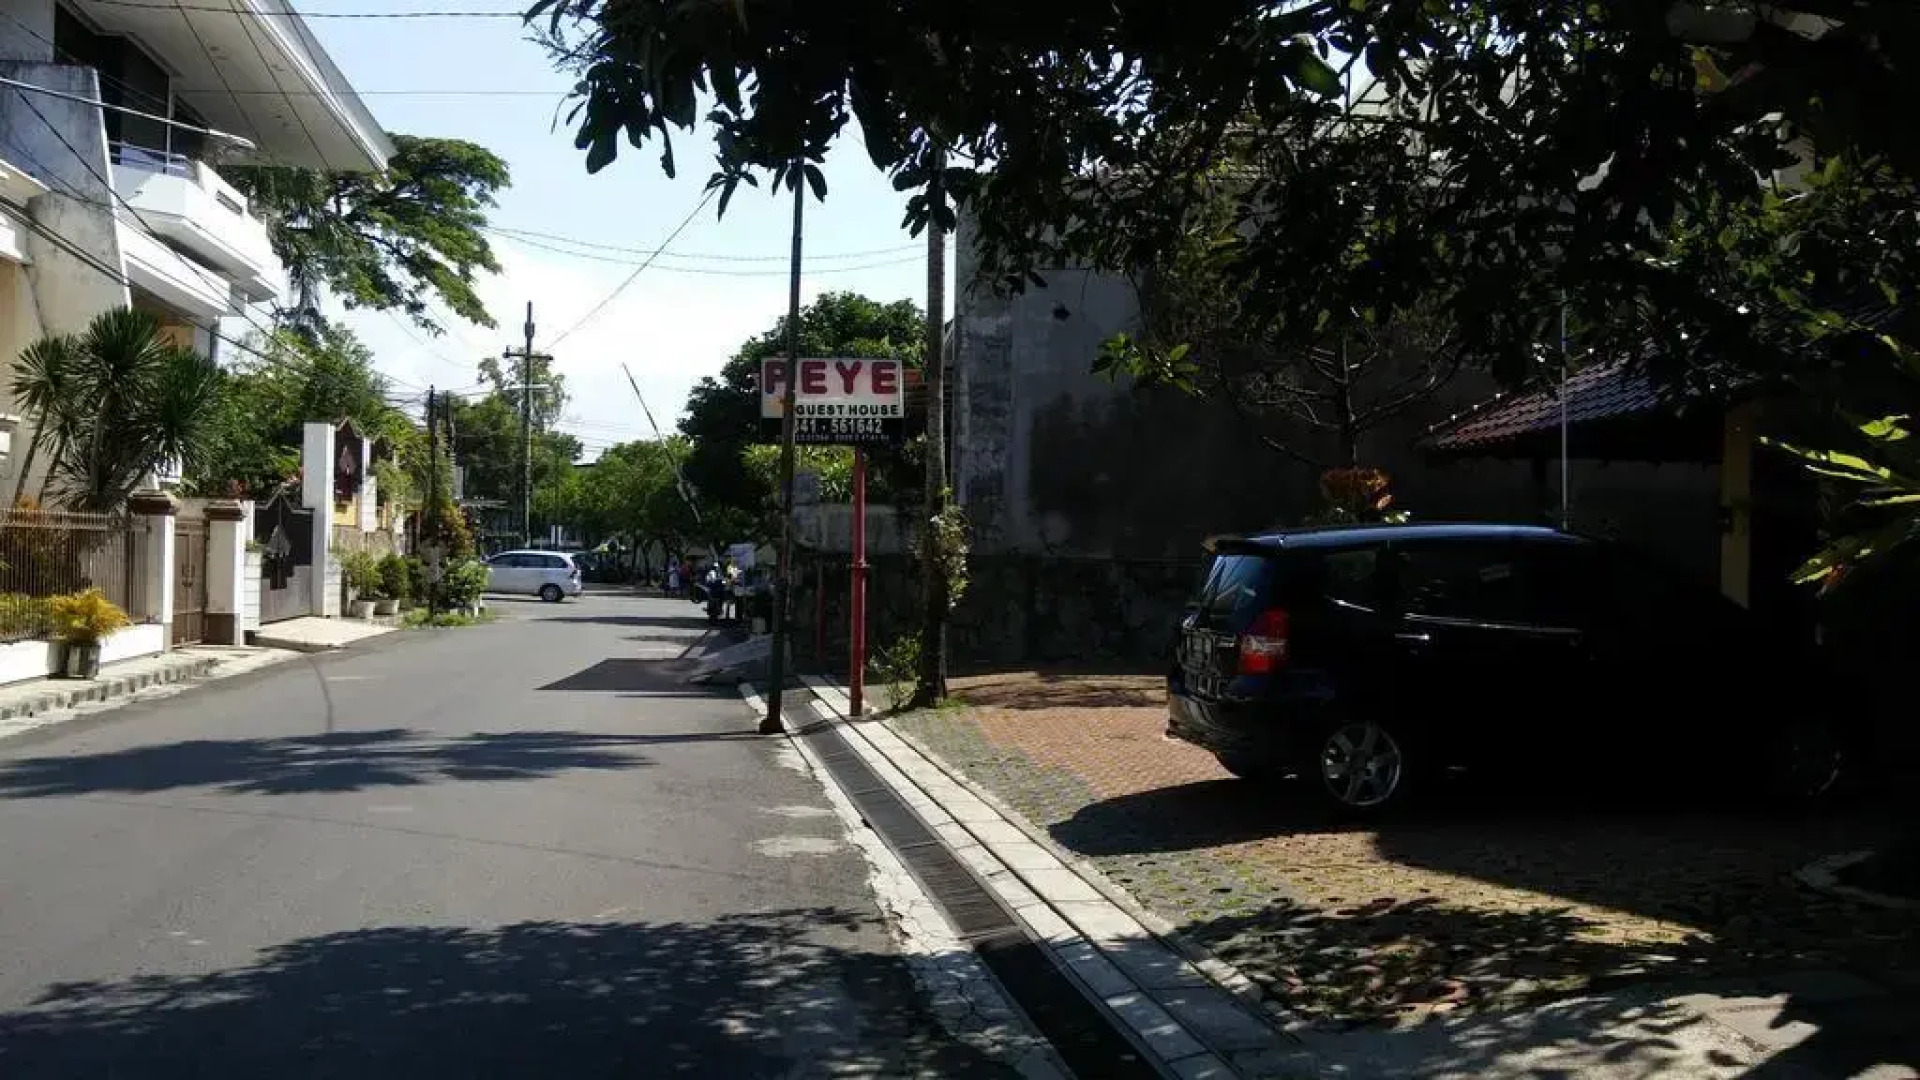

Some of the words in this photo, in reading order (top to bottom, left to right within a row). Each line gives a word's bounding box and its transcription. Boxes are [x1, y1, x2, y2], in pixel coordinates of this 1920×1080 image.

[764, 361, 898, 395] PEYE
[796, 404, 846, 415] GUEST
[849, 404, 899, 415] HOUSE
